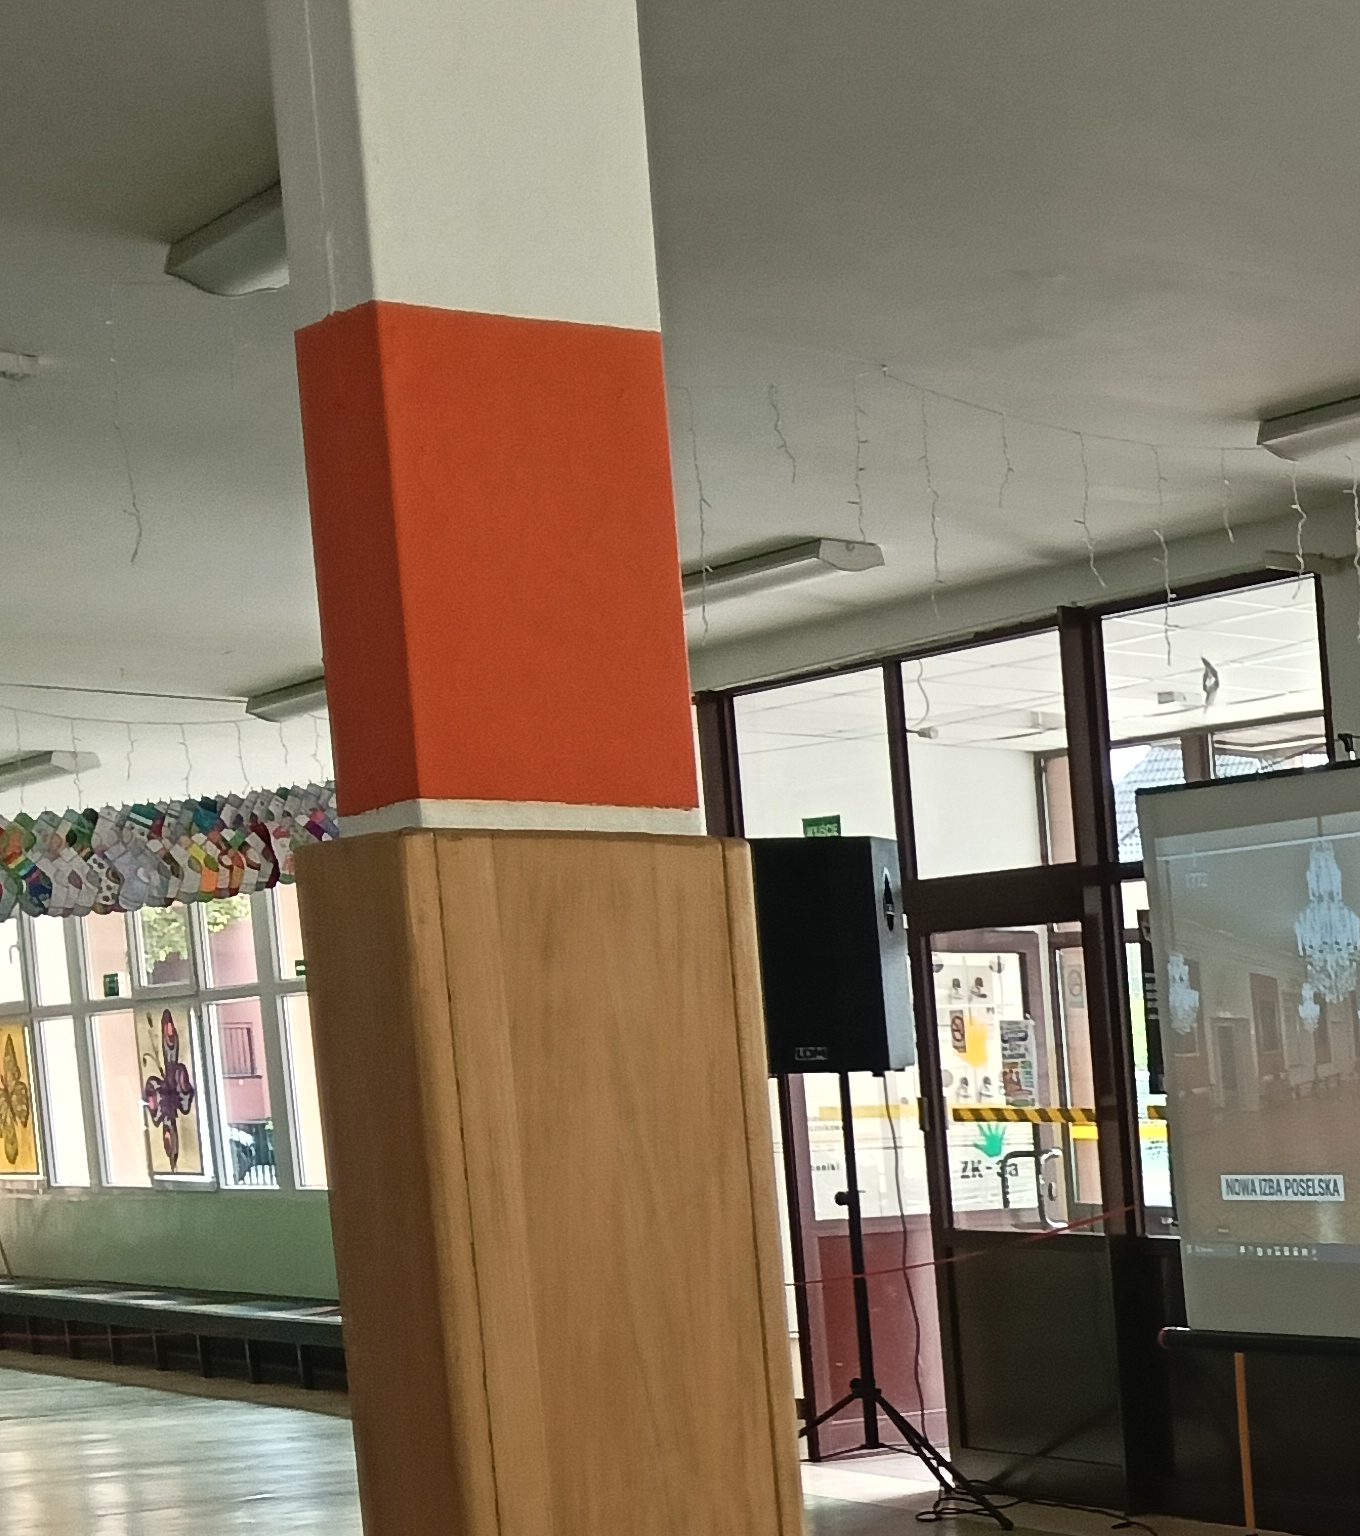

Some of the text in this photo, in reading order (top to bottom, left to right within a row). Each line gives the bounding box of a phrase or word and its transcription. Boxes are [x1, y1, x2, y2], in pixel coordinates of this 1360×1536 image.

[1226, 1178, 1340, 1197] NOWA IZBA POSELSKA
